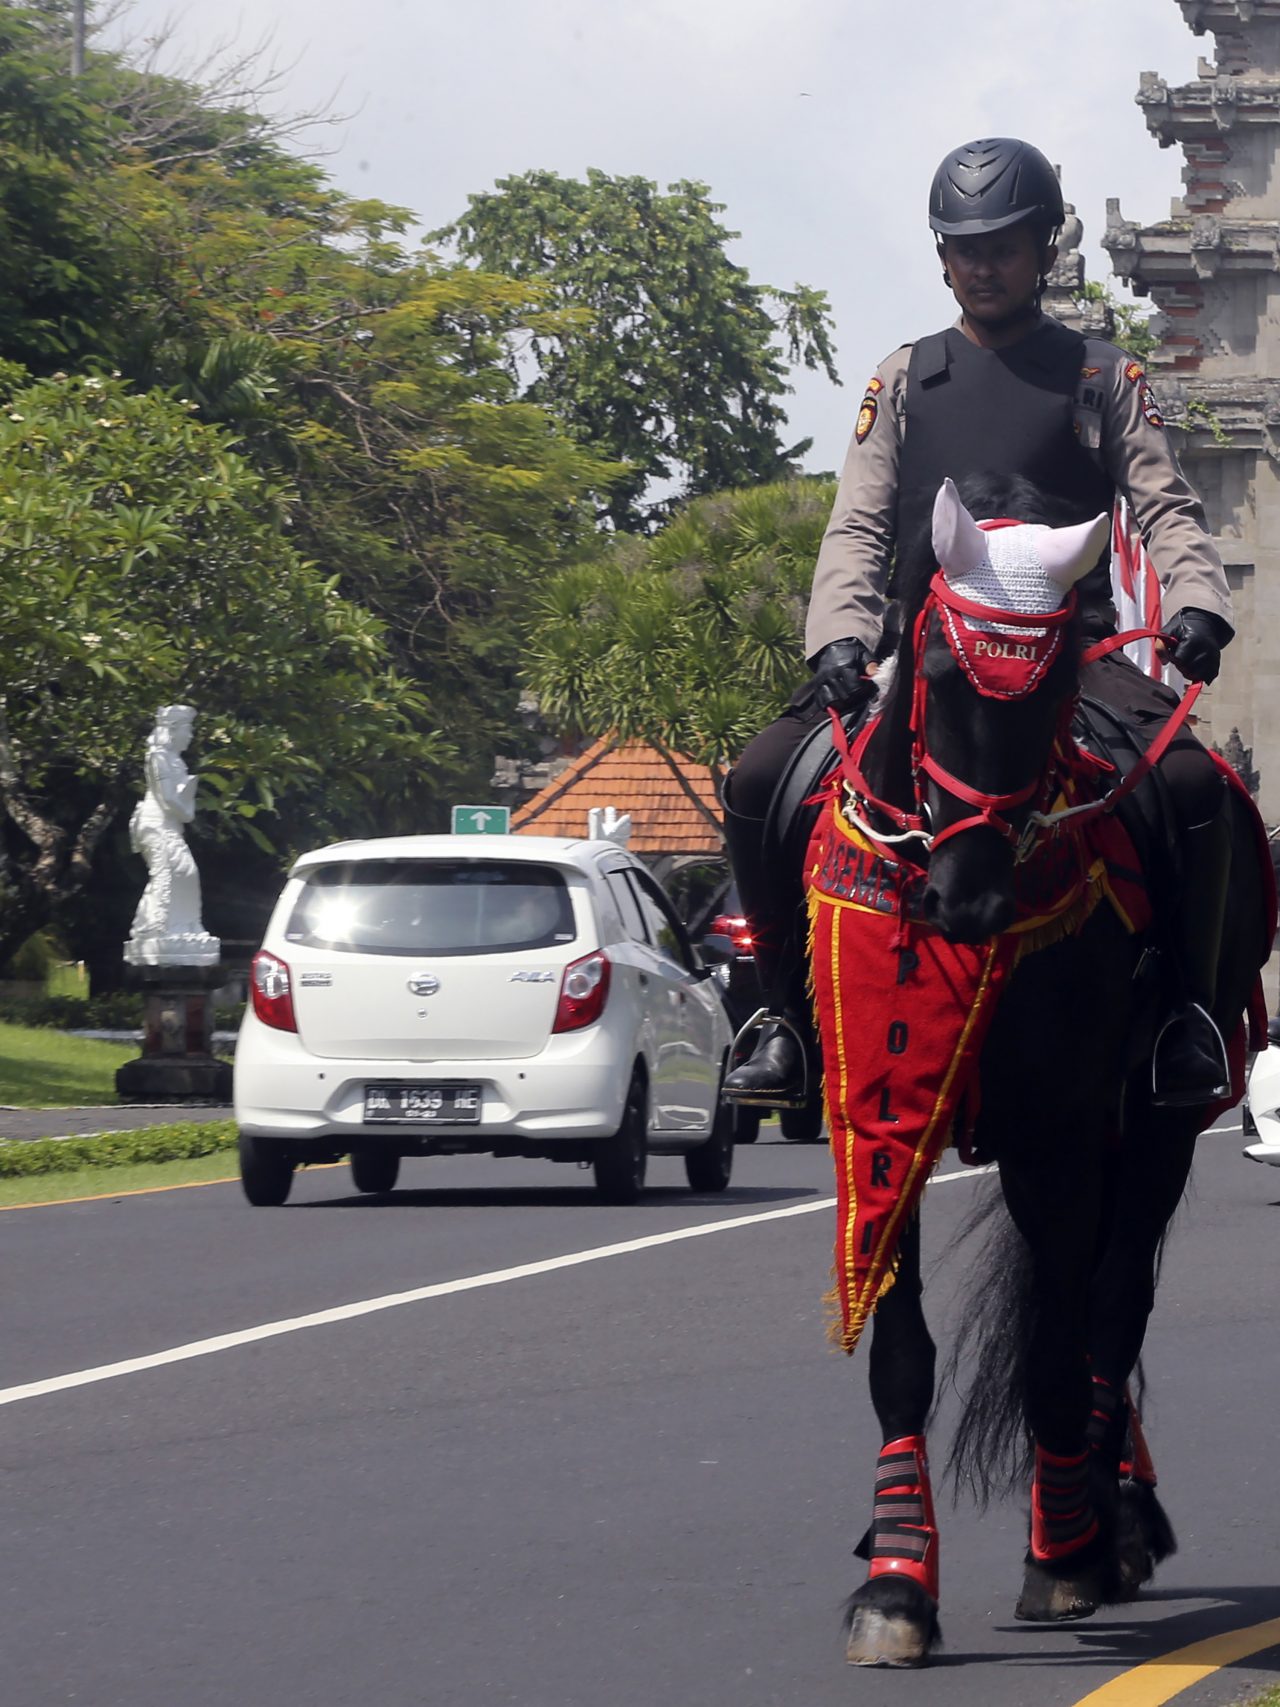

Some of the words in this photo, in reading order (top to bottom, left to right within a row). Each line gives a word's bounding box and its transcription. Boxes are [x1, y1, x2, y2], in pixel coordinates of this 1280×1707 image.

[974, 640, 1038, 661] POLRI
[367, 1090, 391, 1109] DK
[860, 947, 920, 1255] POLRI
